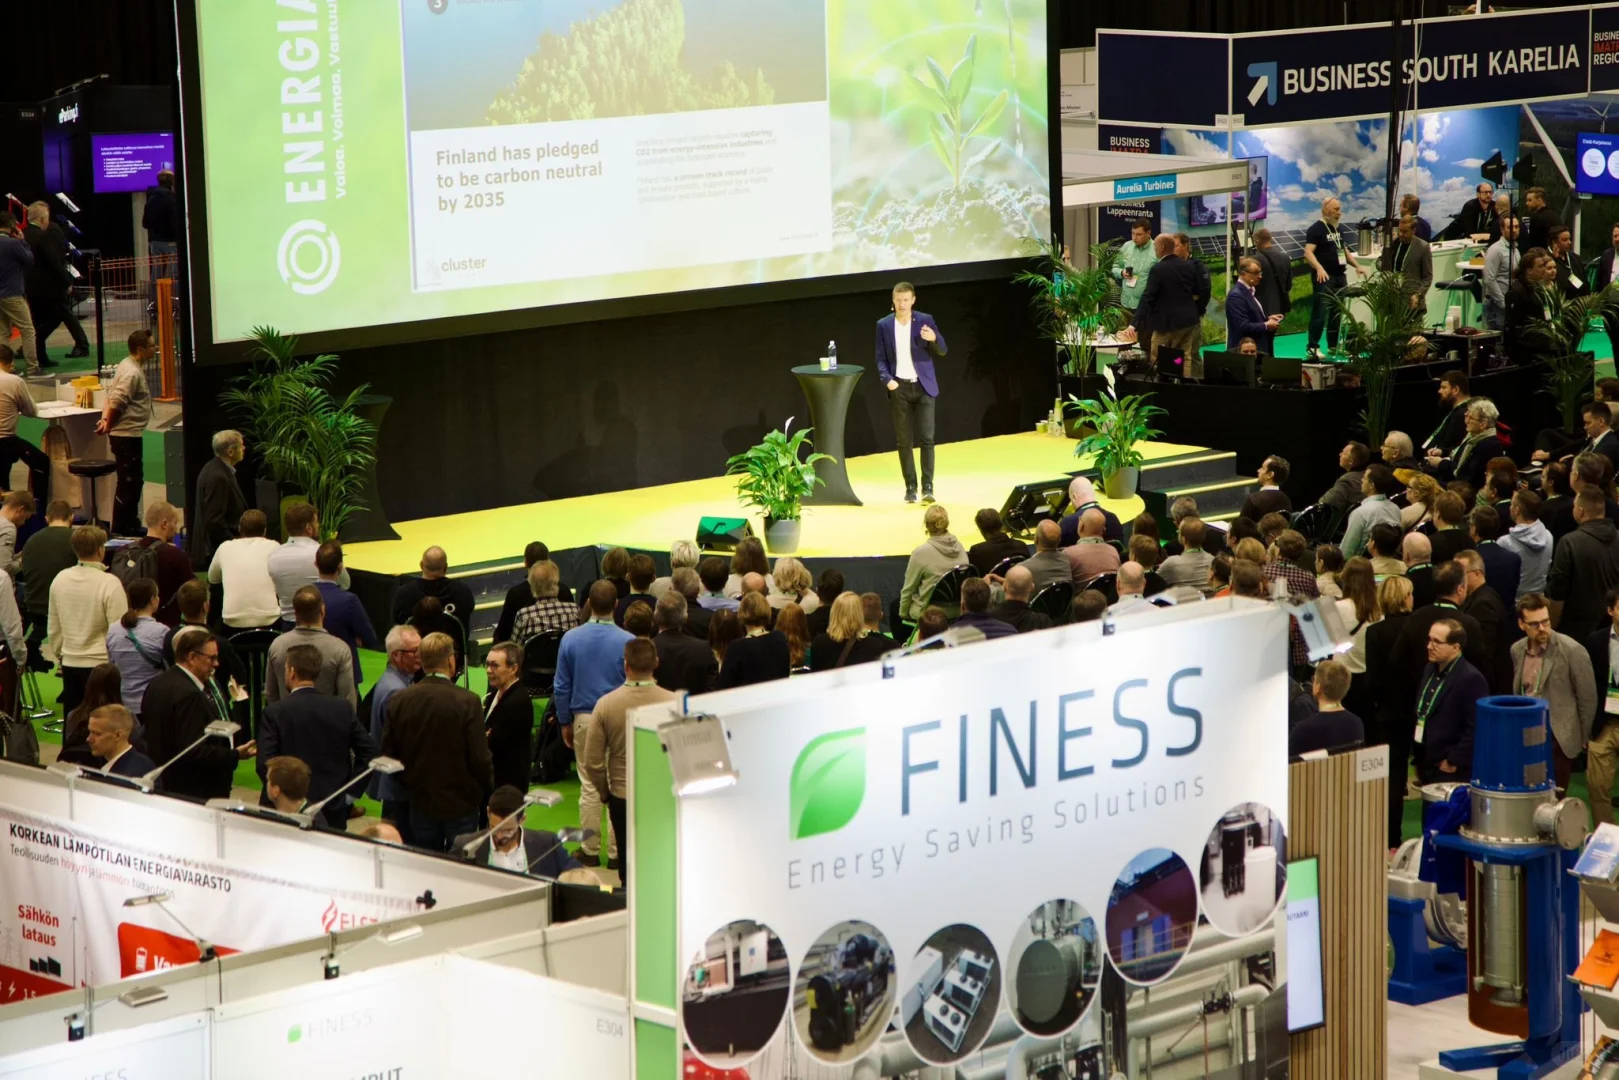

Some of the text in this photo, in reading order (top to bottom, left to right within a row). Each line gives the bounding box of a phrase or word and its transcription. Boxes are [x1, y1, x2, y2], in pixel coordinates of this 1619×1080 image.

[1284, 43, 1580, 95] BUSINESS SOUTH KARELIA
[436, 139, 599, 166] Finland has pledged
[1110, 136, 1150, 148] BUSINESS
[436, 161, 602, 189] to be carbon neutral
[1116, 179, 1175, 195] Aurelia Turbines
[437, 191, 505, 214] by 2035
[1107, 206, 1154, 217] Lappeenranta
[441, 257, 486, 272] cluster
[900, 666, 1204, 816] FINESS
[1361, 757, 1384, 772] E304
[788, 774, 1205, 889] Energy Saving Solutions
[10, 823, 60, 849] KORKEAN
[133, 857, 231, 893] ENERGIAVARASTO
[18, 904, 59, 928] Sähkön
[22, 923, 57, 947] lataus
[308, 1006, 373, 1038] FINESS
[596, 1018, 623, 1037] E304
